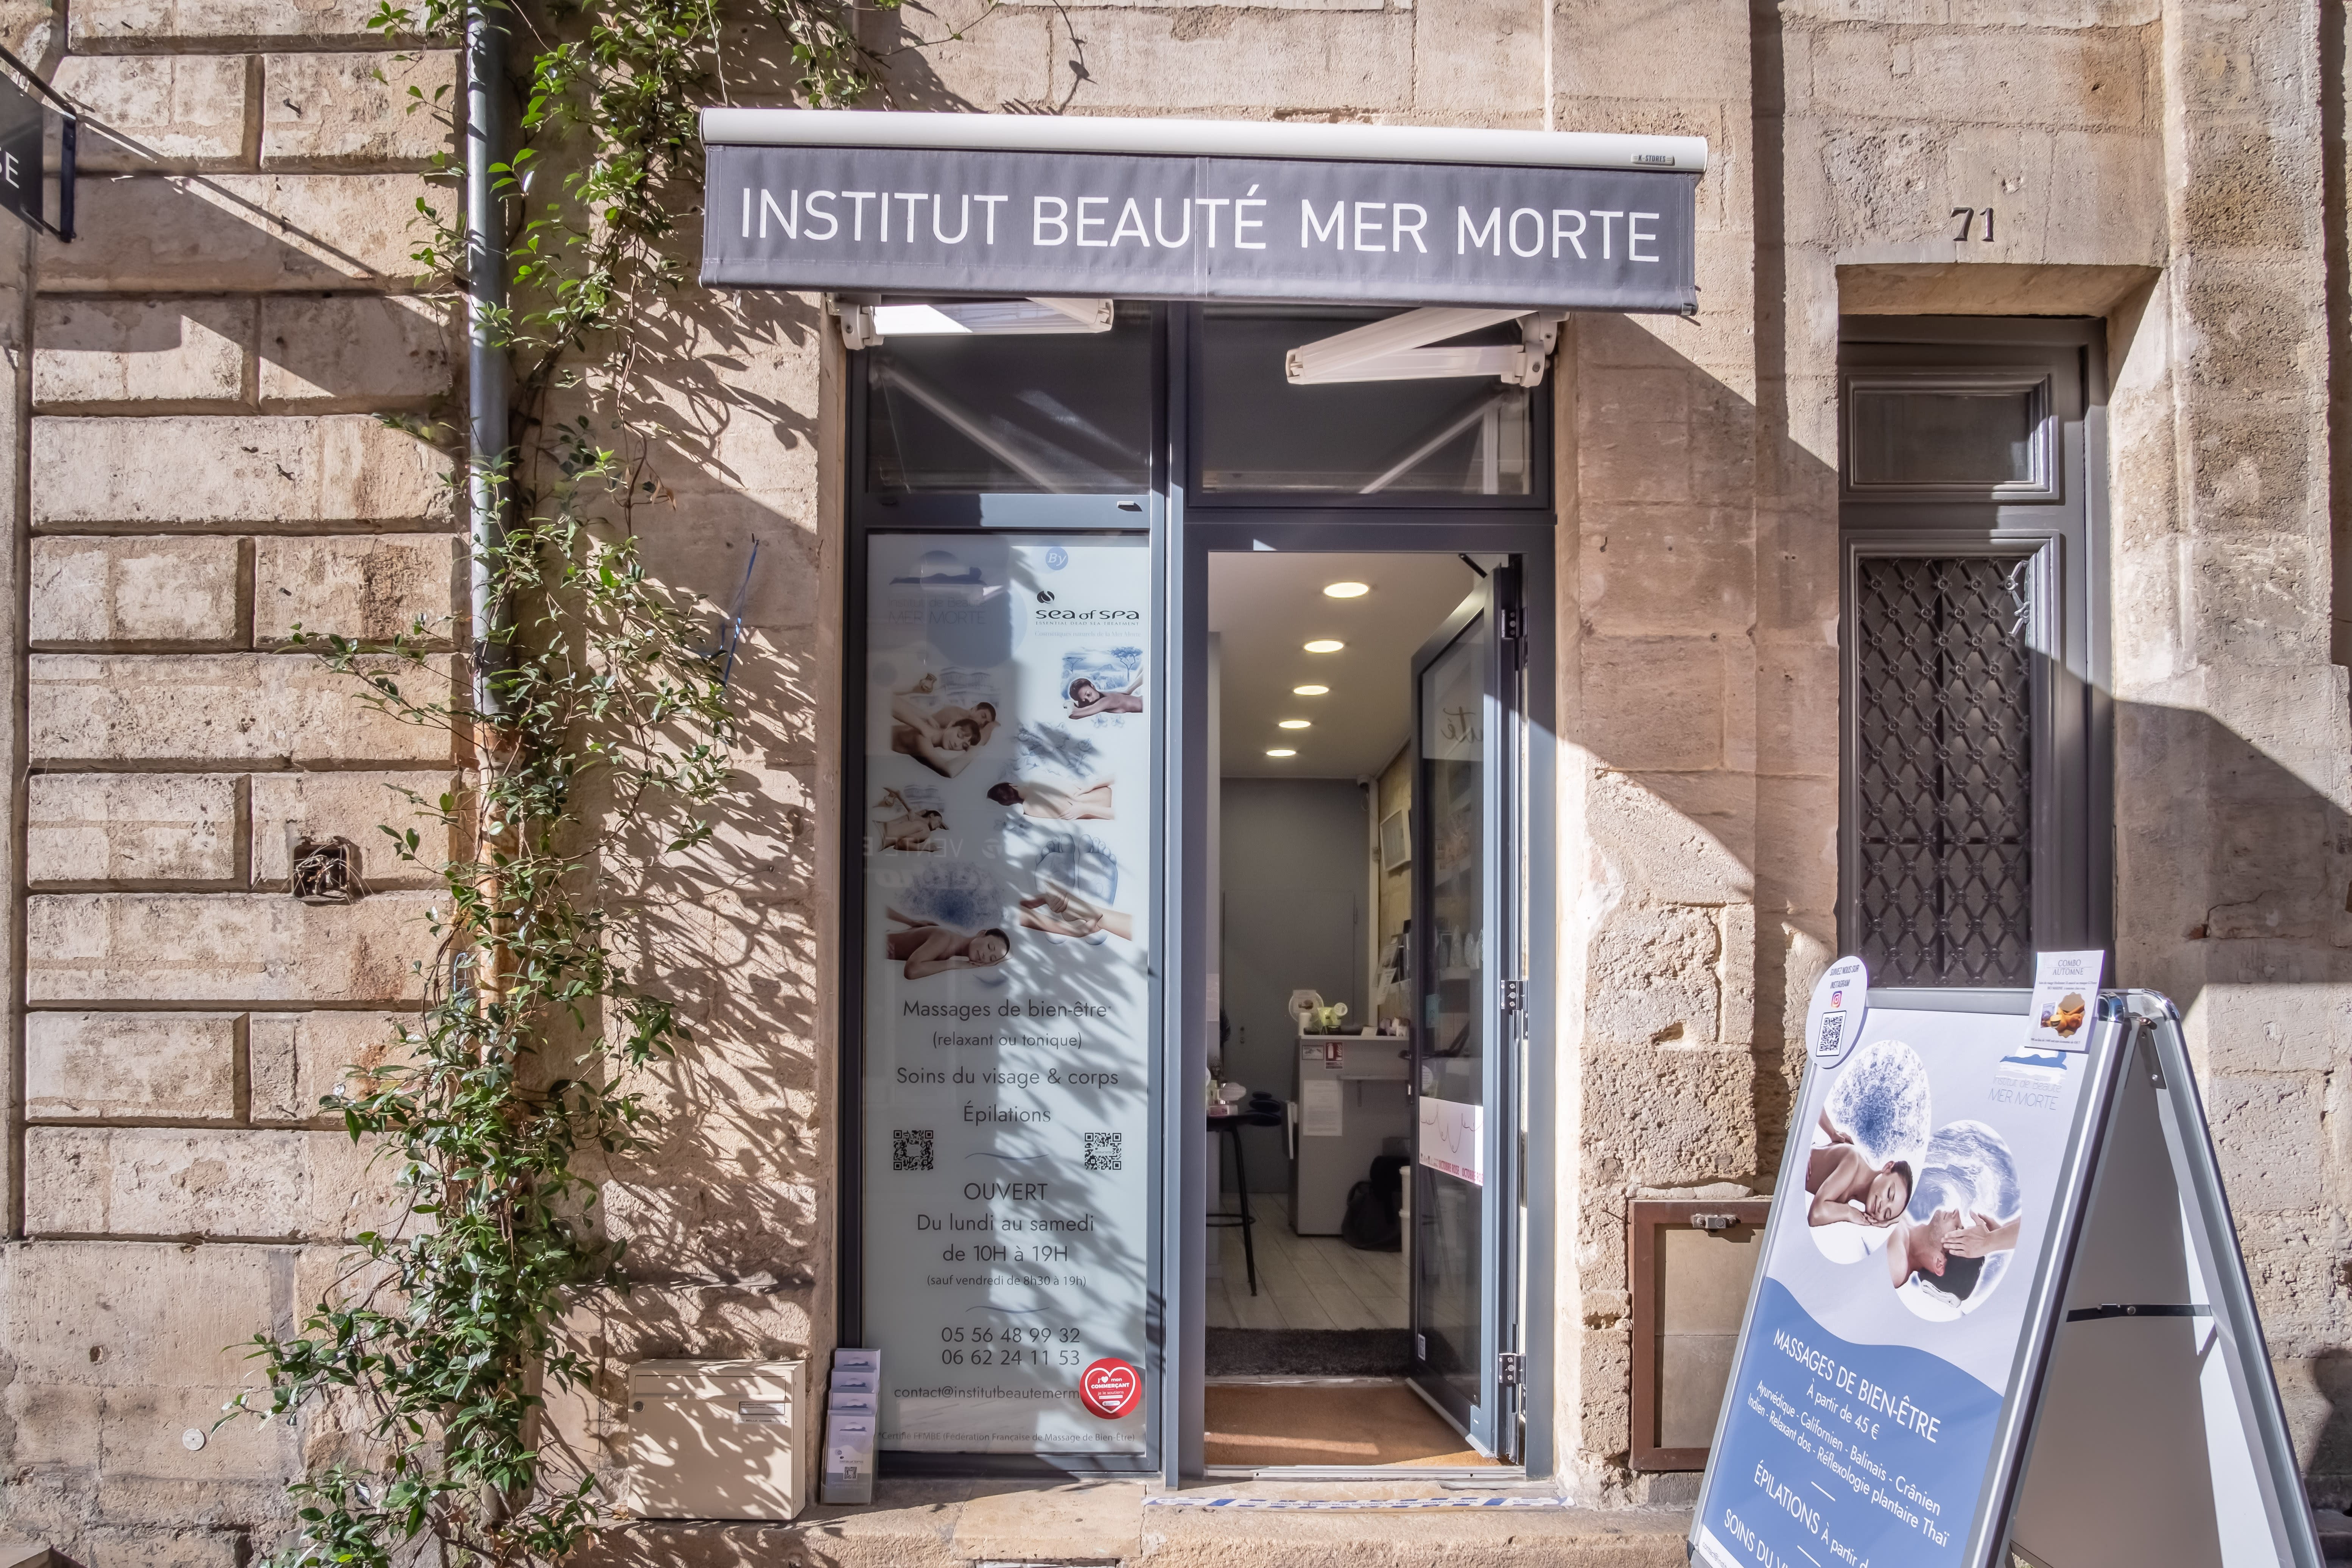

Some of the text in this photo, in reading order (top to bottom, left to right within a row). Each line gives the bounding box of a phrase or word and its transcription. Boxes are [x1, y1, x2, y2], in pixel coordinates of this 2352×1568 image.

[741, 184, 1661, 263] INSTITUT BEAUTÉ MER MORTE
[1951, 207, 1994, 242] 71
[1048, 553, 1066, 566] By
[888, 611, 987, 624] MER MORTE
[1079, 610, 1097, 620] of
[903, 1000, 991, 1021] Massages
[998, 999, 1021, 1017] de
[933, 1032, 1082, 1049] (relaxant ou tonique)
[897, 1066, 1119, 1089] Soins du visage & corps
[1988, 1088, 2059, 1110] MER MORTE
[964, 1100, 1051, 1126] Épilations
[964, 1183, 1048, 1201] OUVERT
[917, 1213, 1094, 1232] Du lundi au samedi
[942, 1244, 1068, 1262] de 10H à 19H
[927, 1274, 1087, 1287] (sauf vendredi de 8h30 à 19h)
[941, 1327, 1080, 1343] 05 56 48 99 32
[941, 1349, 1080, 1365] 06 62 24 11 53
[1773, 1328, 1941, 1443] MASSAGES DE BIEN-ÊTRE
[1806, 1379, 1880, 1440] À partir de 45 €
[943, 1432, 990, 1442] (Fédération
[992, 1433, 1030, 1443] Française
[1032, 1433, 1043, 1441] de
[1045, 1433, 1081, 1443] Massage
[1083, 1433, 1093, 1441] de
[1095, 1433, 1135, 1442] Bien-Être)
[1756, 1380, 1795, 1418] Ayurvédique
[1800, 1412, 1843, 1452] Californien
[1849, 1445, 1887, 1482] Balinais
[1895, 1476, 1941, 1516] Crânien
[1748, 1392, 1765, 1417] Indien
[1770, 1409, 1797, 1442] Relaxant
[1797, 1435, 1811, 1454] dos
[1817, 1446, 1870, 1496] Réflexologie
[1871, 1488, 1919, 1529] plantaire
[1922, 1516, 1951, 1548] Thaï
[1753, 1460, 1821, 1534] ÉPILATIONS
[1821, 1522, 1831, 1545] À
[1830, 1538, 1858, 1567] partir
[1724, 1508, 1774, 1568] SOINS DU
